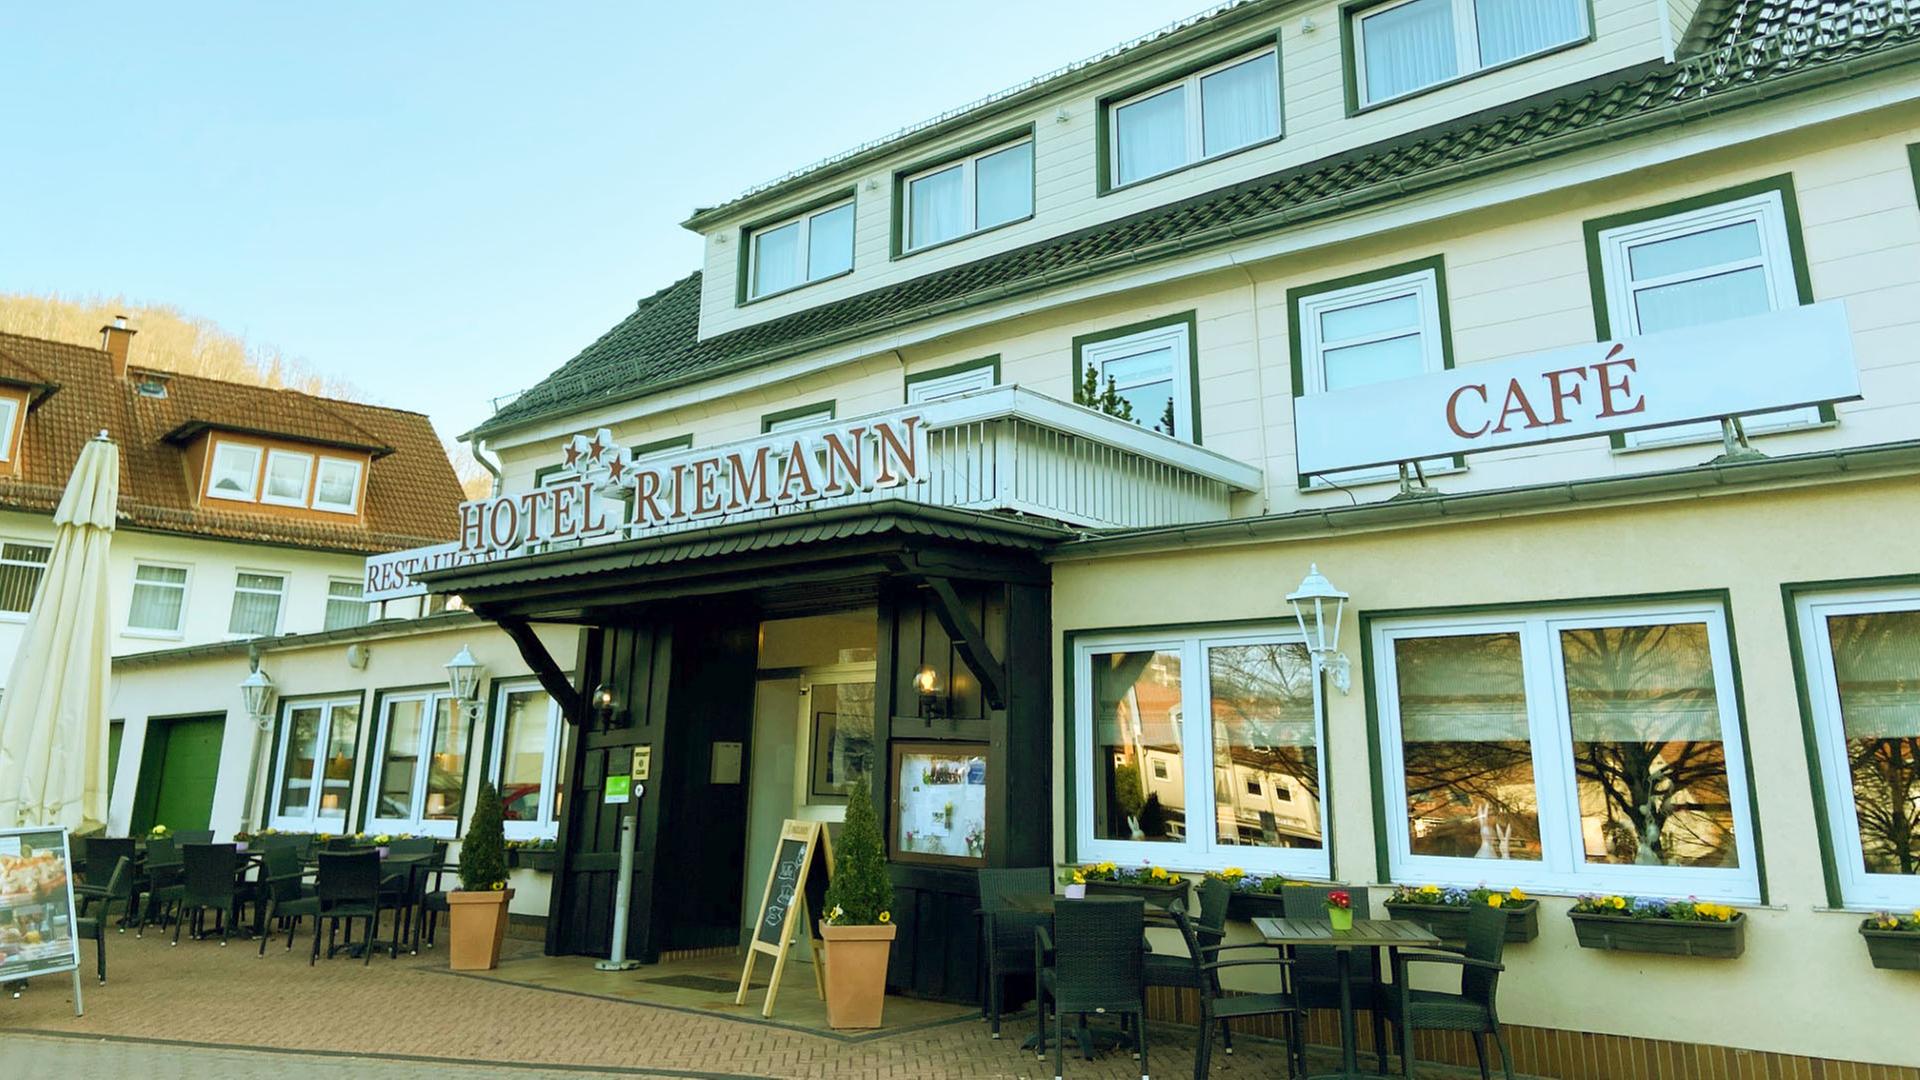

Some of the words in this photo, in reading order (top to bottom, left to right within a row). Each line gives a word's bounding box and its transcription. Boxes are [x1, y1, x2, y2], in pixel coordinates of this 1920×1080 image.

[1446, 343, 1646, 439] CAFÉ
[459, 482, 605, 551] HOTEL
[633, 416, 920, 525] RIEMANN
[366, 550, 510, 593] RESTAUR
